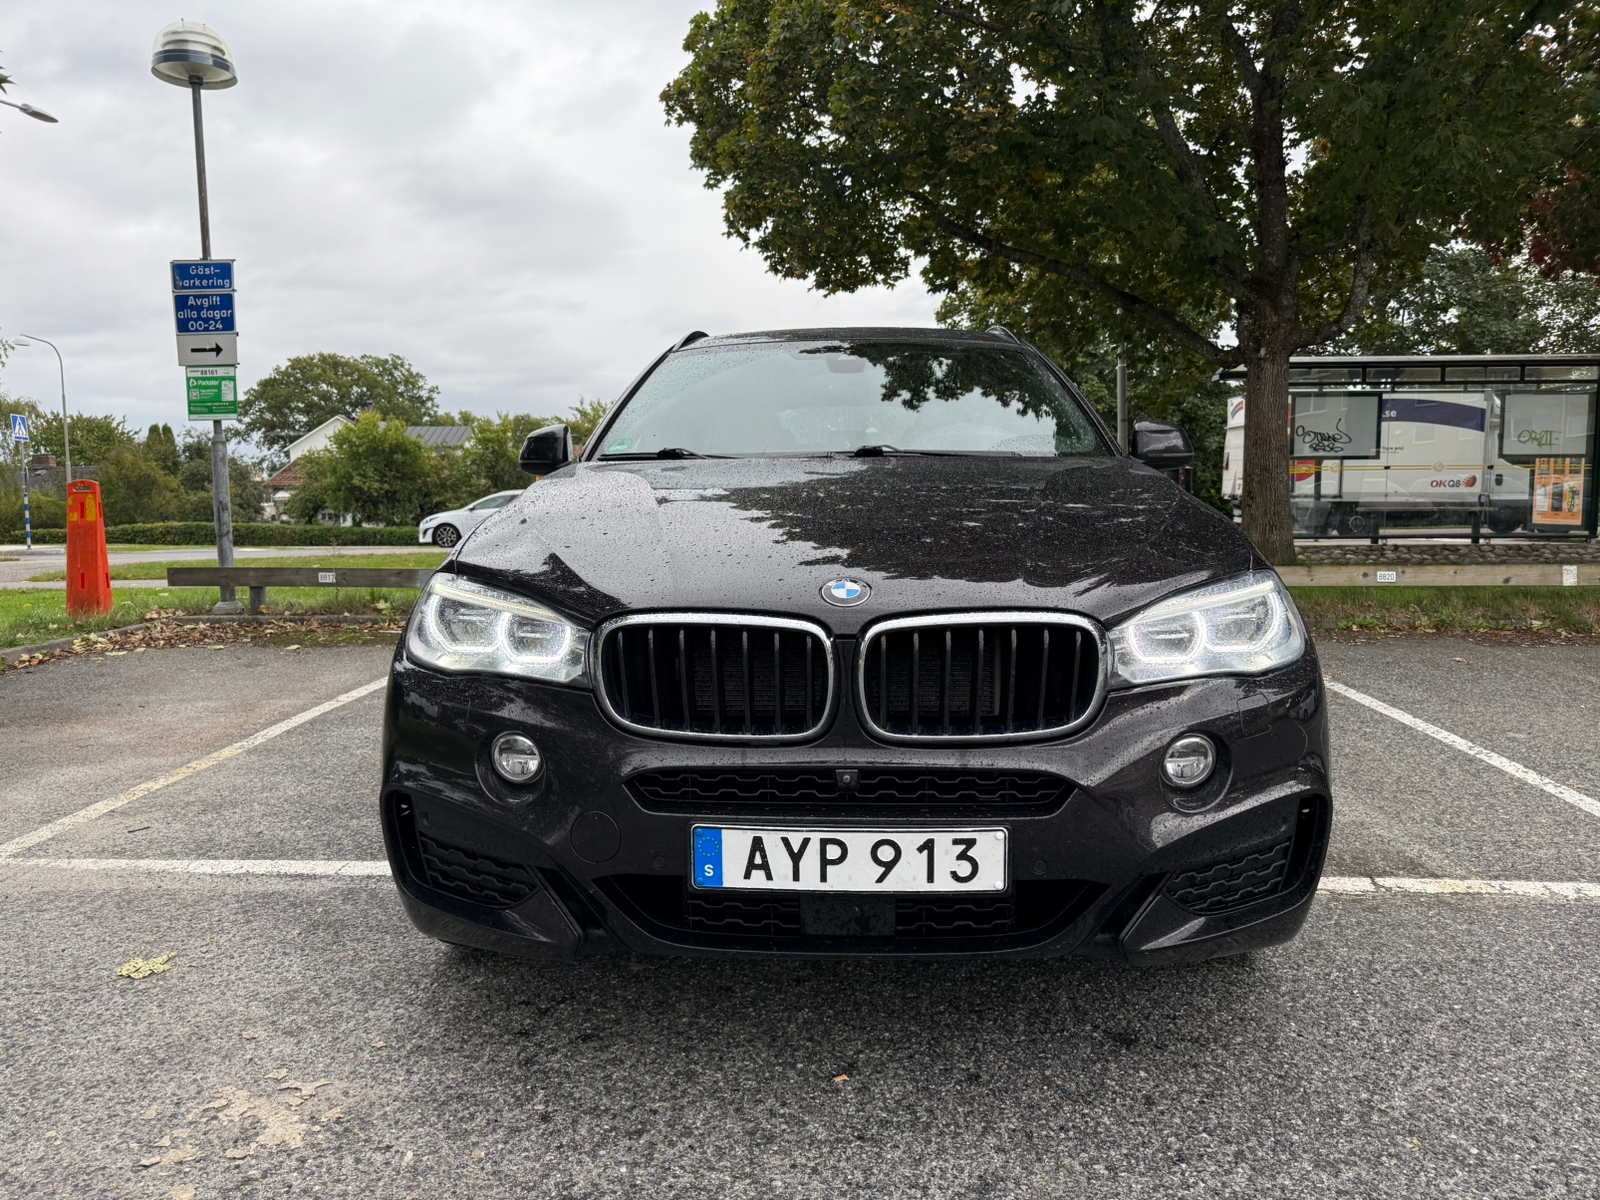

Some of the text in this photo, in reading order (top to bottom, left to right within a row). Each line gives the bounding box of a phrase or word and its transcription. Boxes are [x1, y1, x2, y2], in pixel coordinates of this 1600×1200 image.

[189, 265, 220, 275] Gäst-
[187, 295, 220, 308] Avgift
[177, 308, 232, 320] alla dagar
[188, 320, 223, 331] 00-24
[1430, 479, 1461, 488] OKQ8
[1379, 573, 1395, 581] 8820
[743, 835, 980, 884] AYP 913
[704, 864, 714, 877] S
